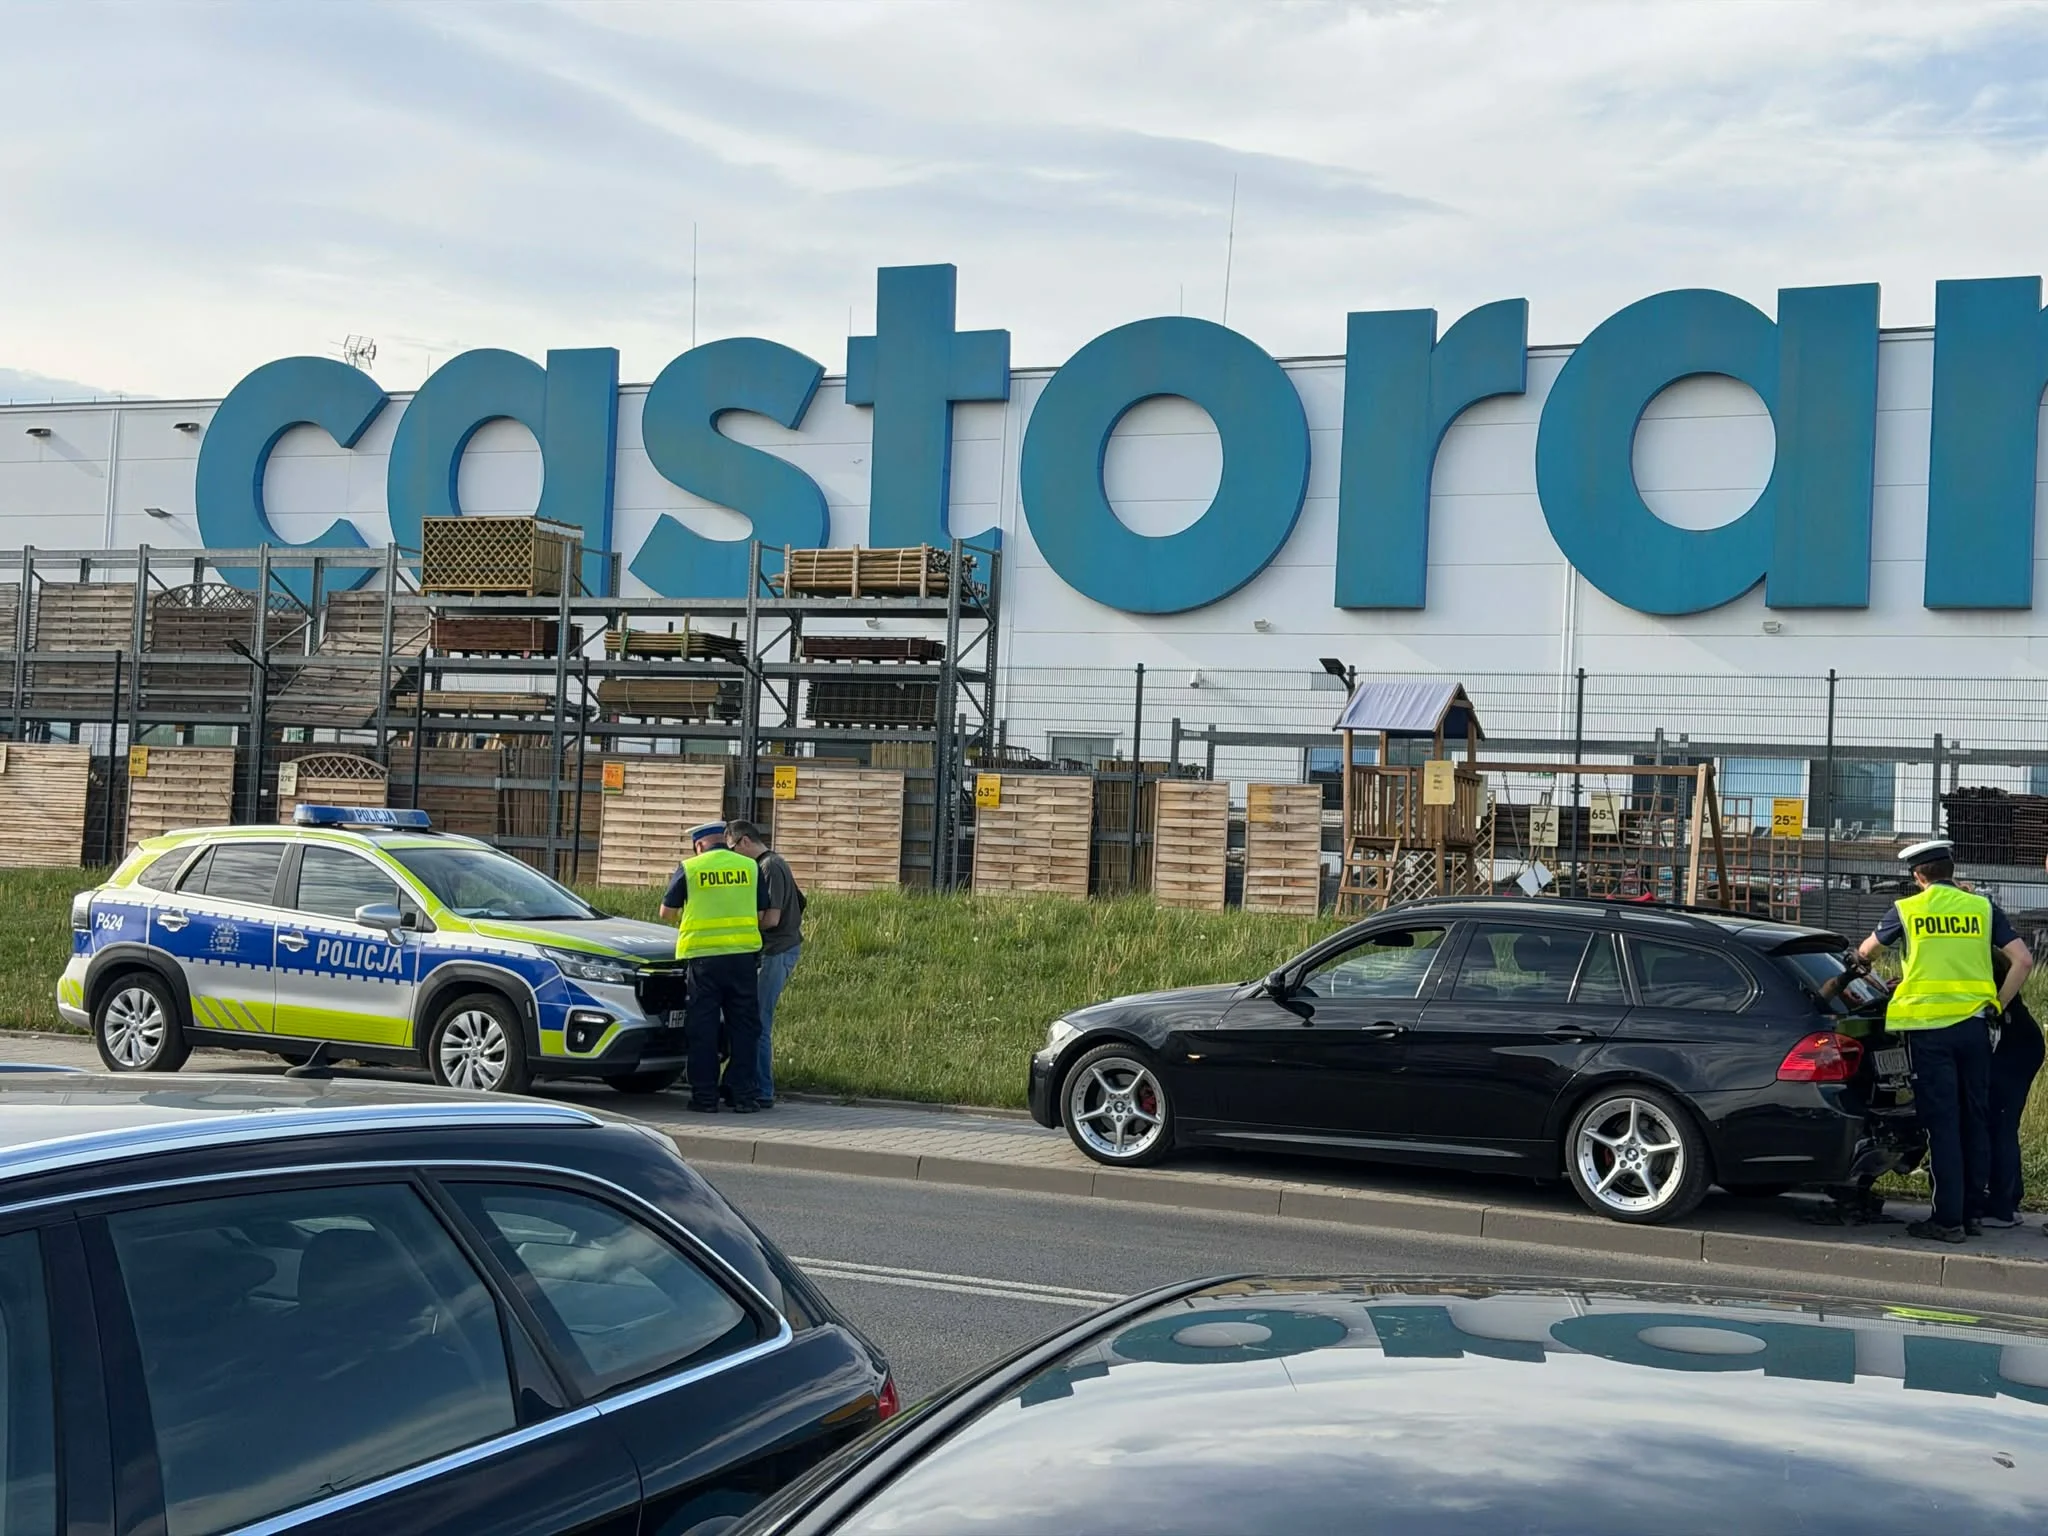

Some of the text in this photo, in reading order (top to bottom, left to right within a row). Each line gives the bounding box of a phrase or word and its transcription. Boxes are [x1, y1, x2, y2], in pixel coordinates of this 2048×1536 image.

[353, 808, 395, 823] POLICJA
[700, 870, 749, 887] POLICJA
[95, 911, 125, 931] P624
[1914, 916, 1980, 935] POLICJA
[316, 938, 403, 975] POLICJA
